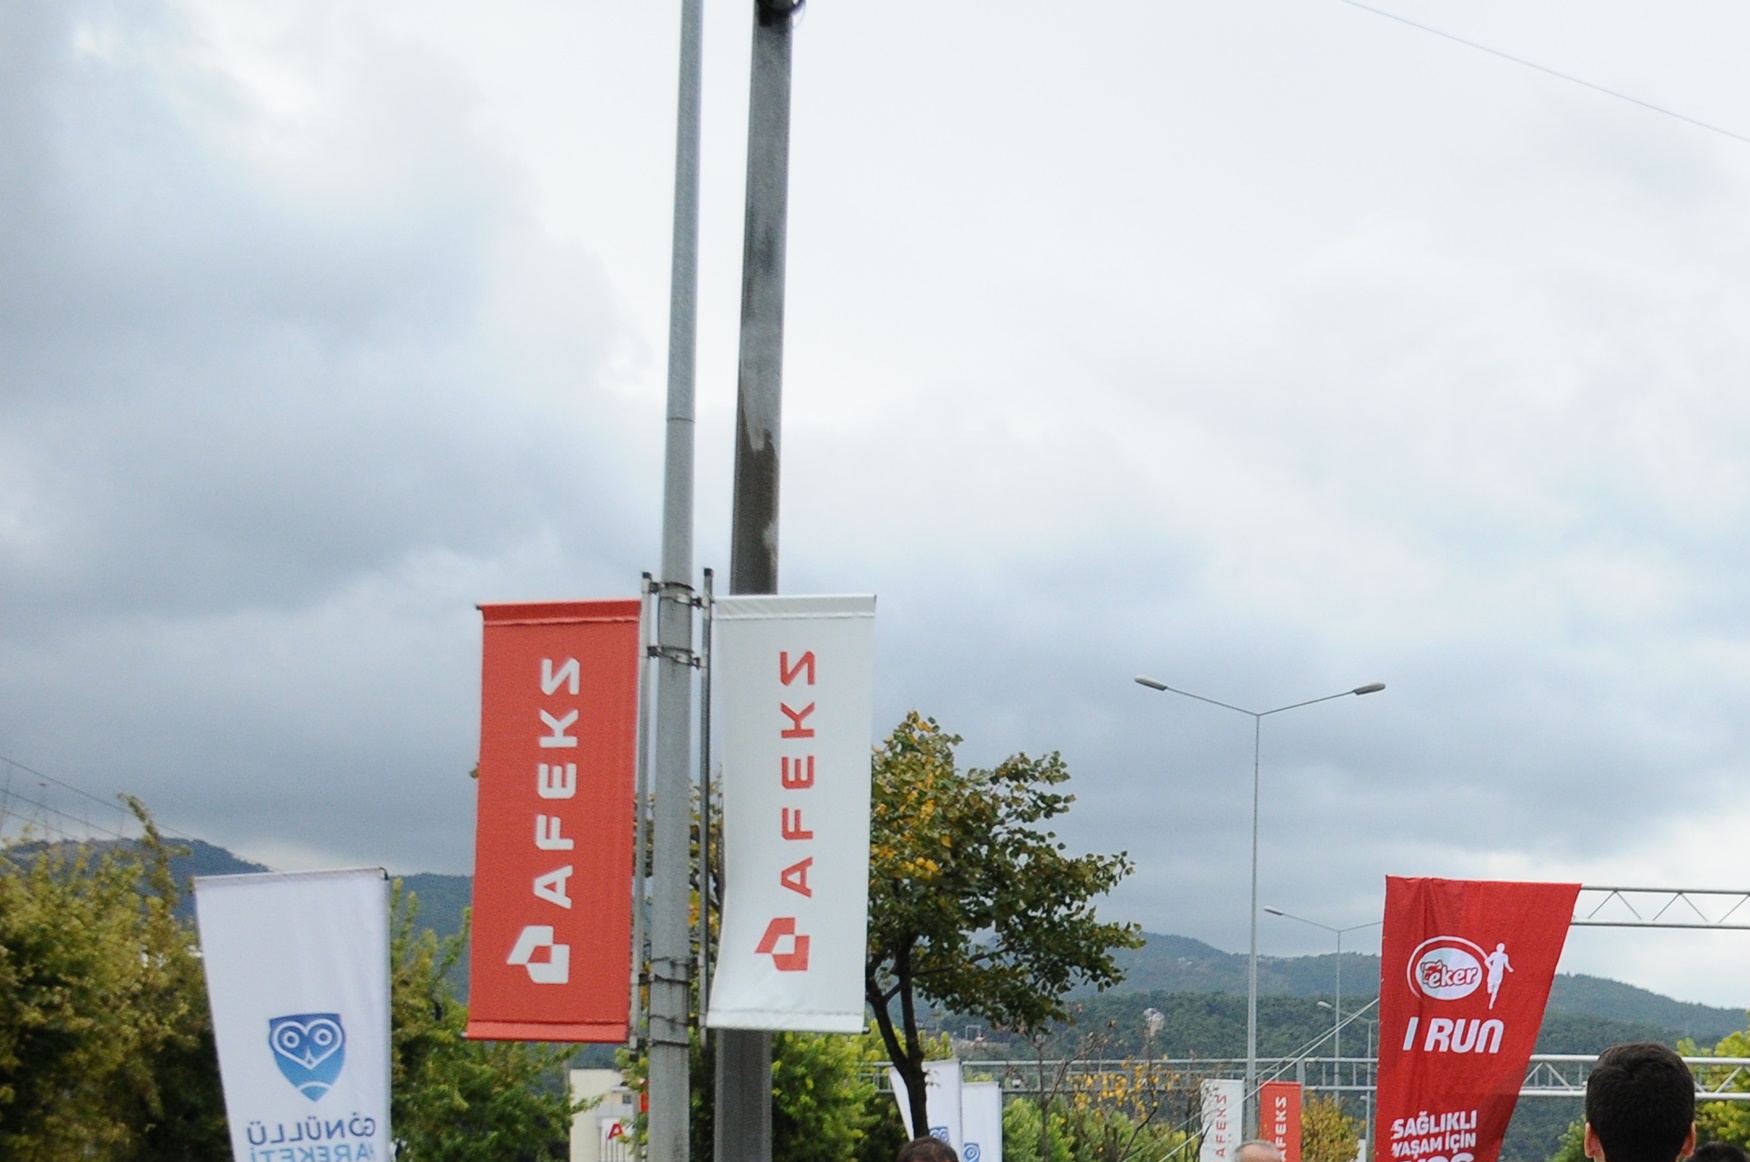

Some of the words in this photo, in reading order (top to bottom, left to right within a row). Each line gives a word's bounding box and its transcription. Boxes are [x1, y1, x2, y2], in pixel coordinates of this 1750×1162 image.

[533, 656, 581, 910] AFEKS
[780, 650, 816, 898] AFEKS
[1427, 965, 1478, 989] eker
[1402, 1016, 1419, 1051] I
[1424, 1018, 1505, 1054] RUN
[1391, 1110, 1478, 1140] SAĞLIKLI
[1391, 1138, 1443, 1158] YAŞAM
[1444, 1130, 1477, 1153] İÇİN
